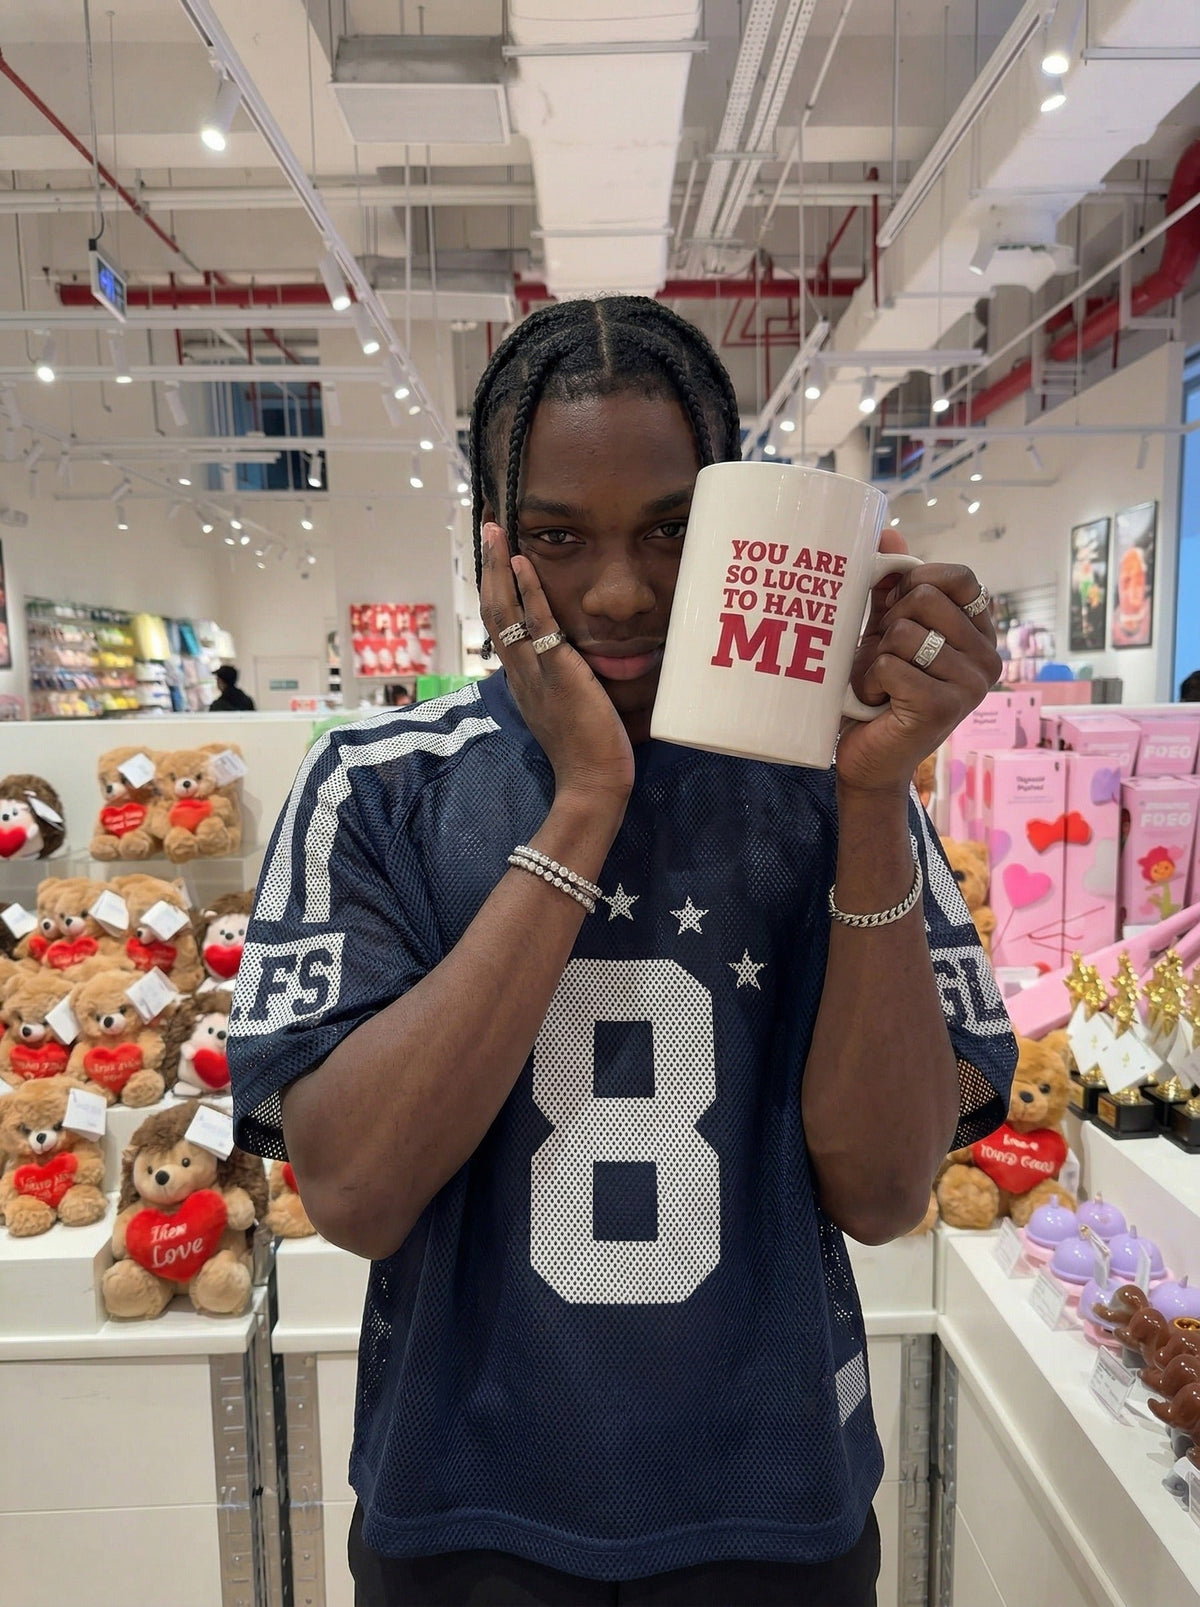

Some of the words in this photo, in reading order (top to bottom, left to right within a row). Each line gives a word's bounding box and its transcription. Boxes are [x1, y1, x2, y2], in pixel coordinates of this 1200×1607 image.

[732, 540, 789, 564] YOU
[793, 548, 847, 577] ARE
[726, 565, 758, 585] SO
[763, 569, 843, 600] LUCKY
[723, 588, 758, 610] TO
[763, 593, 837, 625] HAVE
[711, 613, 833, 684] ME
[231, 947, 333, 1020] FS
[530, 958, 720, 1304] 8
[152, 1238, 204, 1268] Love
